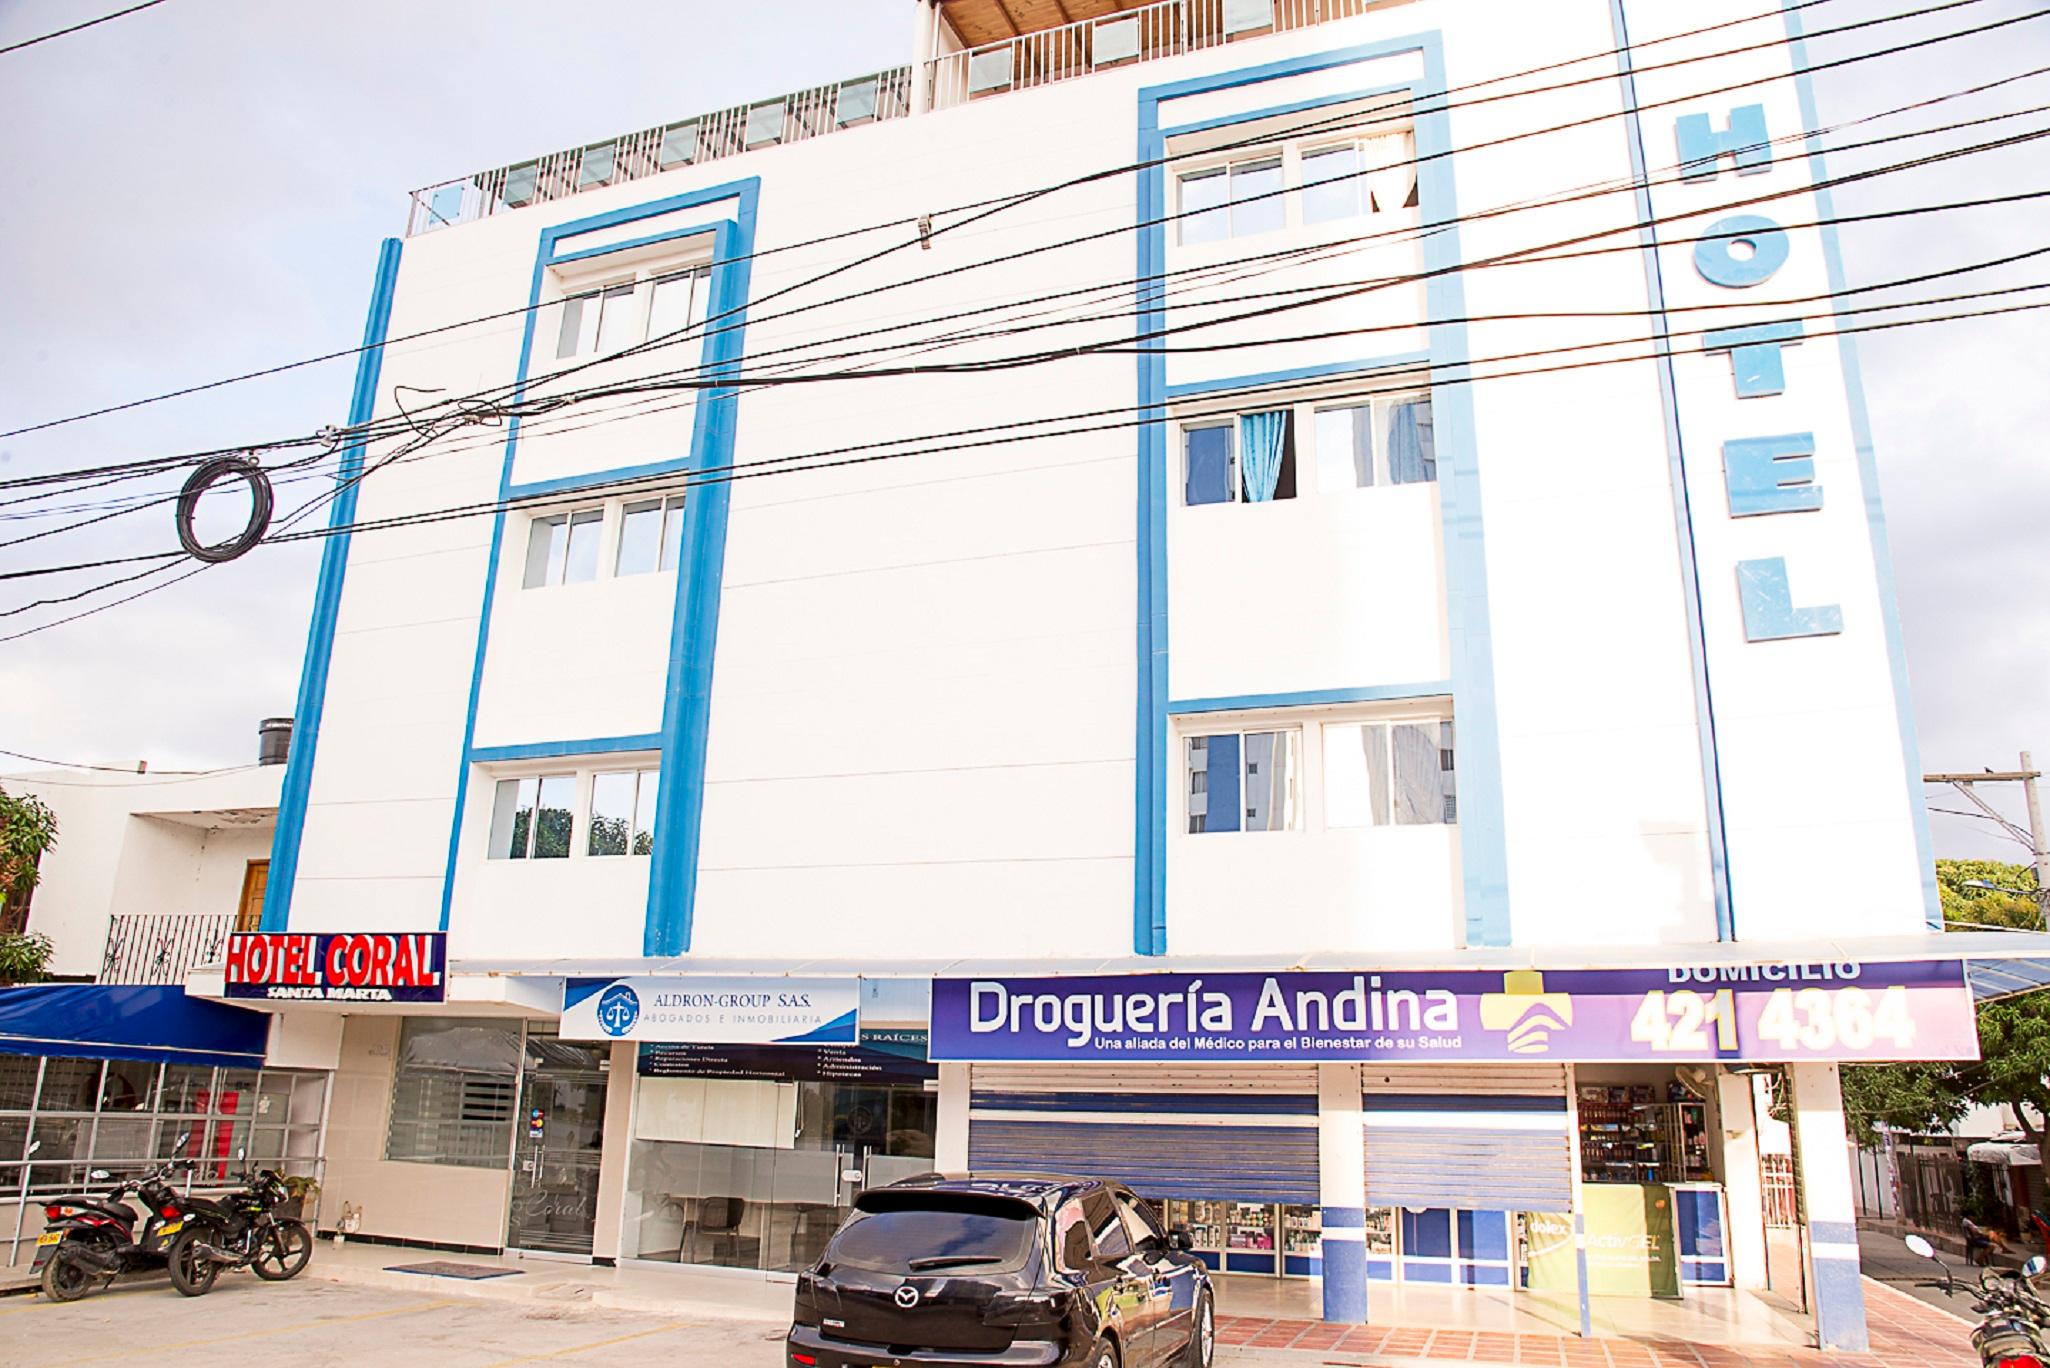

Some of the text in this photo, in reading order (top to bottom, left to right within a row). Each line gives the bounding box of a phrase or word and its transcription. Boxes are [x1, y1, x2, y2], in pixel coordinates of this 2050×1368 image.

[1675, 103, 1844, 643] HOTEL
[224, 935, 440, 987] HOTEL CORAL
[1667, 962, 1861, 983] DOMICILIO
[267, 987, 392, 1000] SANTA MARTA
[653, 993, 771, 1007] ALDRON-GROUP
[643, 1013, 822, 1024] ABOGADOS E INMOBILIARIA
[970, 976, 1458, 1047] Droguería Andina
[1630, 986, 1916, 1050] 421 4364
[1095, 1035, 1462, 1052] Una aliada del Médico para el Bienestar de su Salud
[526, 1189, 588, 1218] Coral
[1530, 1219, 1567, 1235] dolex
